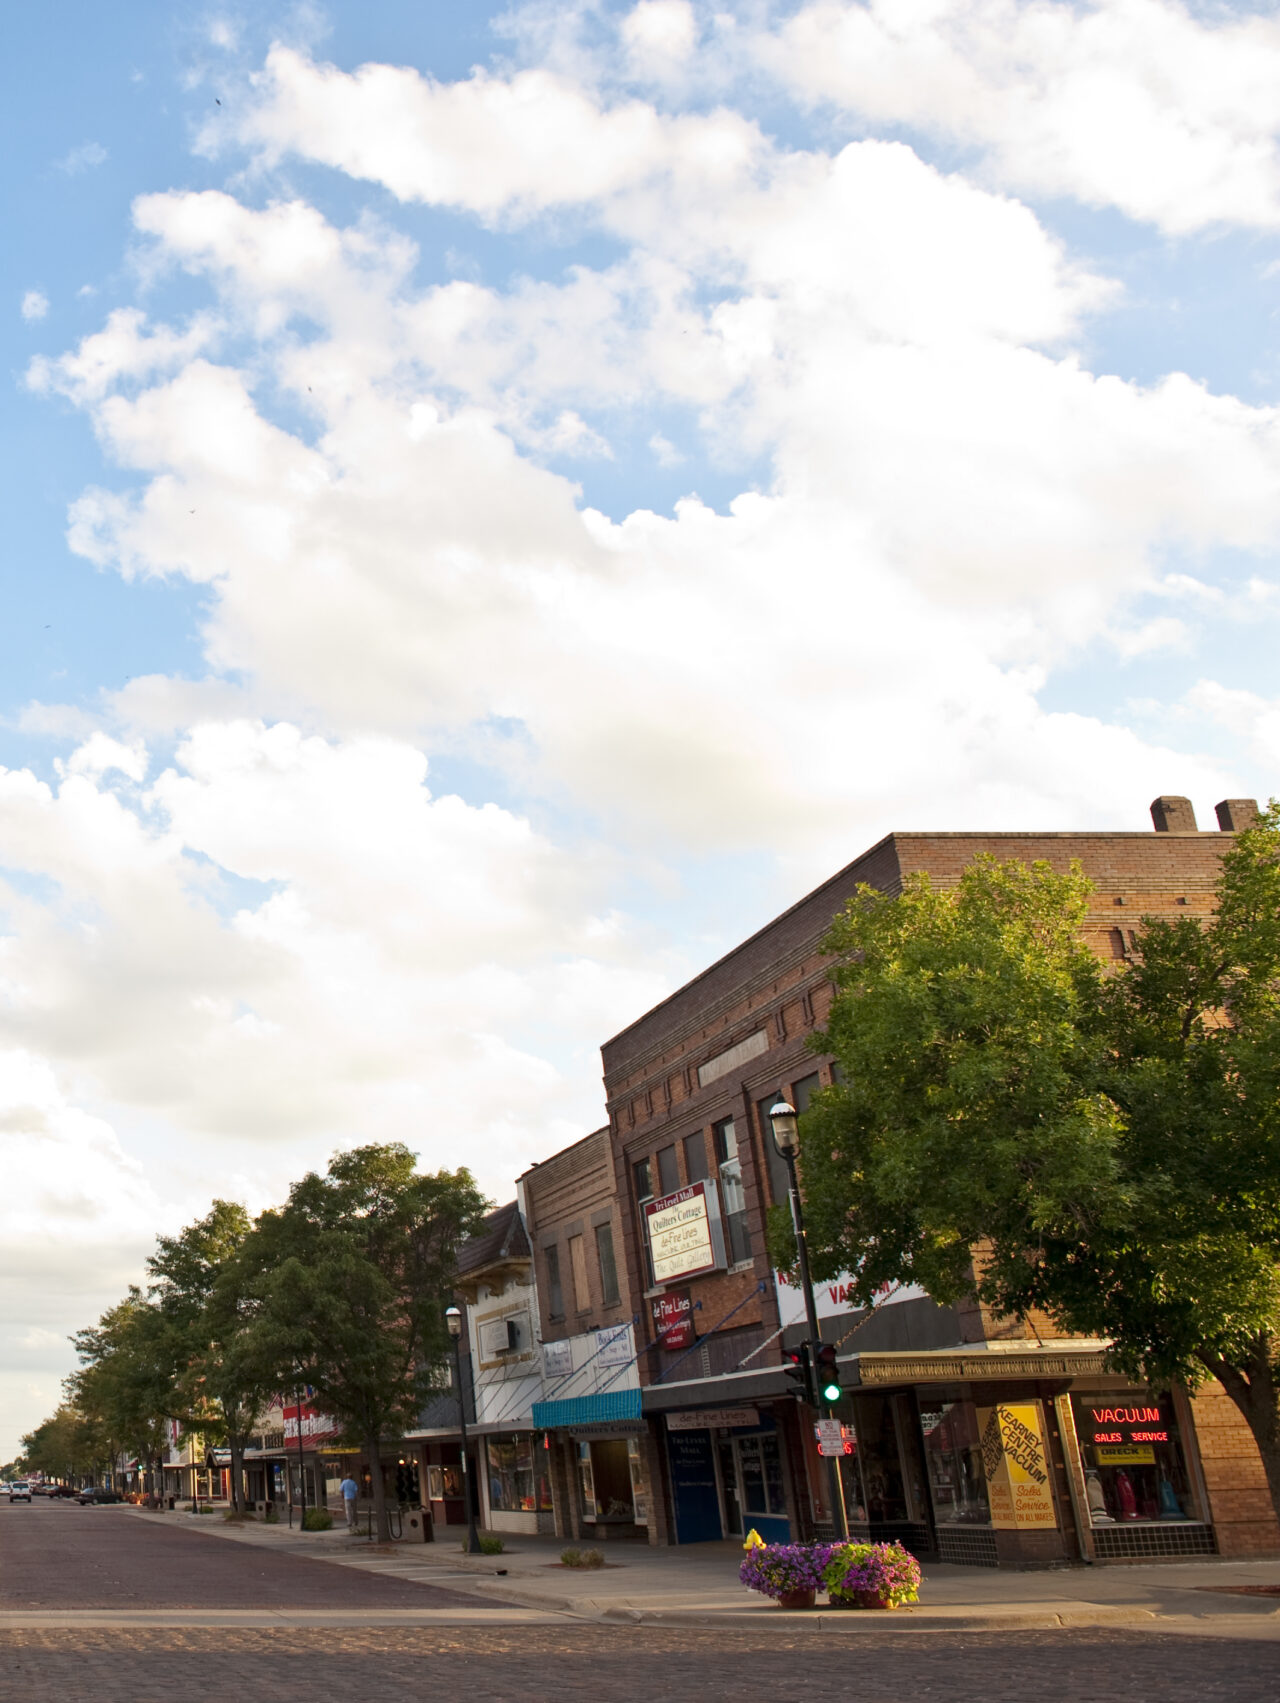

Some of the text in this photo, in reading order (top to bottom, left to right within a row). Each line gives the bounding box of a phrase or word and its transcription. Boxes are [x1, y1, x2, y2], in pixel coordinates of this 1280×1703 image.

[654, 1188, 695, 1211] Tri-Level Mall
[652, 1205, 702, 1233] Quilters Cottage
[1092, 1408, 1160, 1423] VACUUM
[570, 1423, 647, 1435] Quilters Cottage
[997, 1406, 1042, 1449] KEARNEY
[1094, 1431, 1168, 1442] SALES SERVICE
[1001, 1425, 1043, 1466] CENTRE
[1101, 1448, 1139, 1456] ORECK
[1003, 1441, 1047, 1485] VACUUM
[1016, 1485, 1042, 1497] Sales
[1015, 1499, 1050, 1511] Service
[1016, 1512, 1054, 1521] ON ALL MAKES
